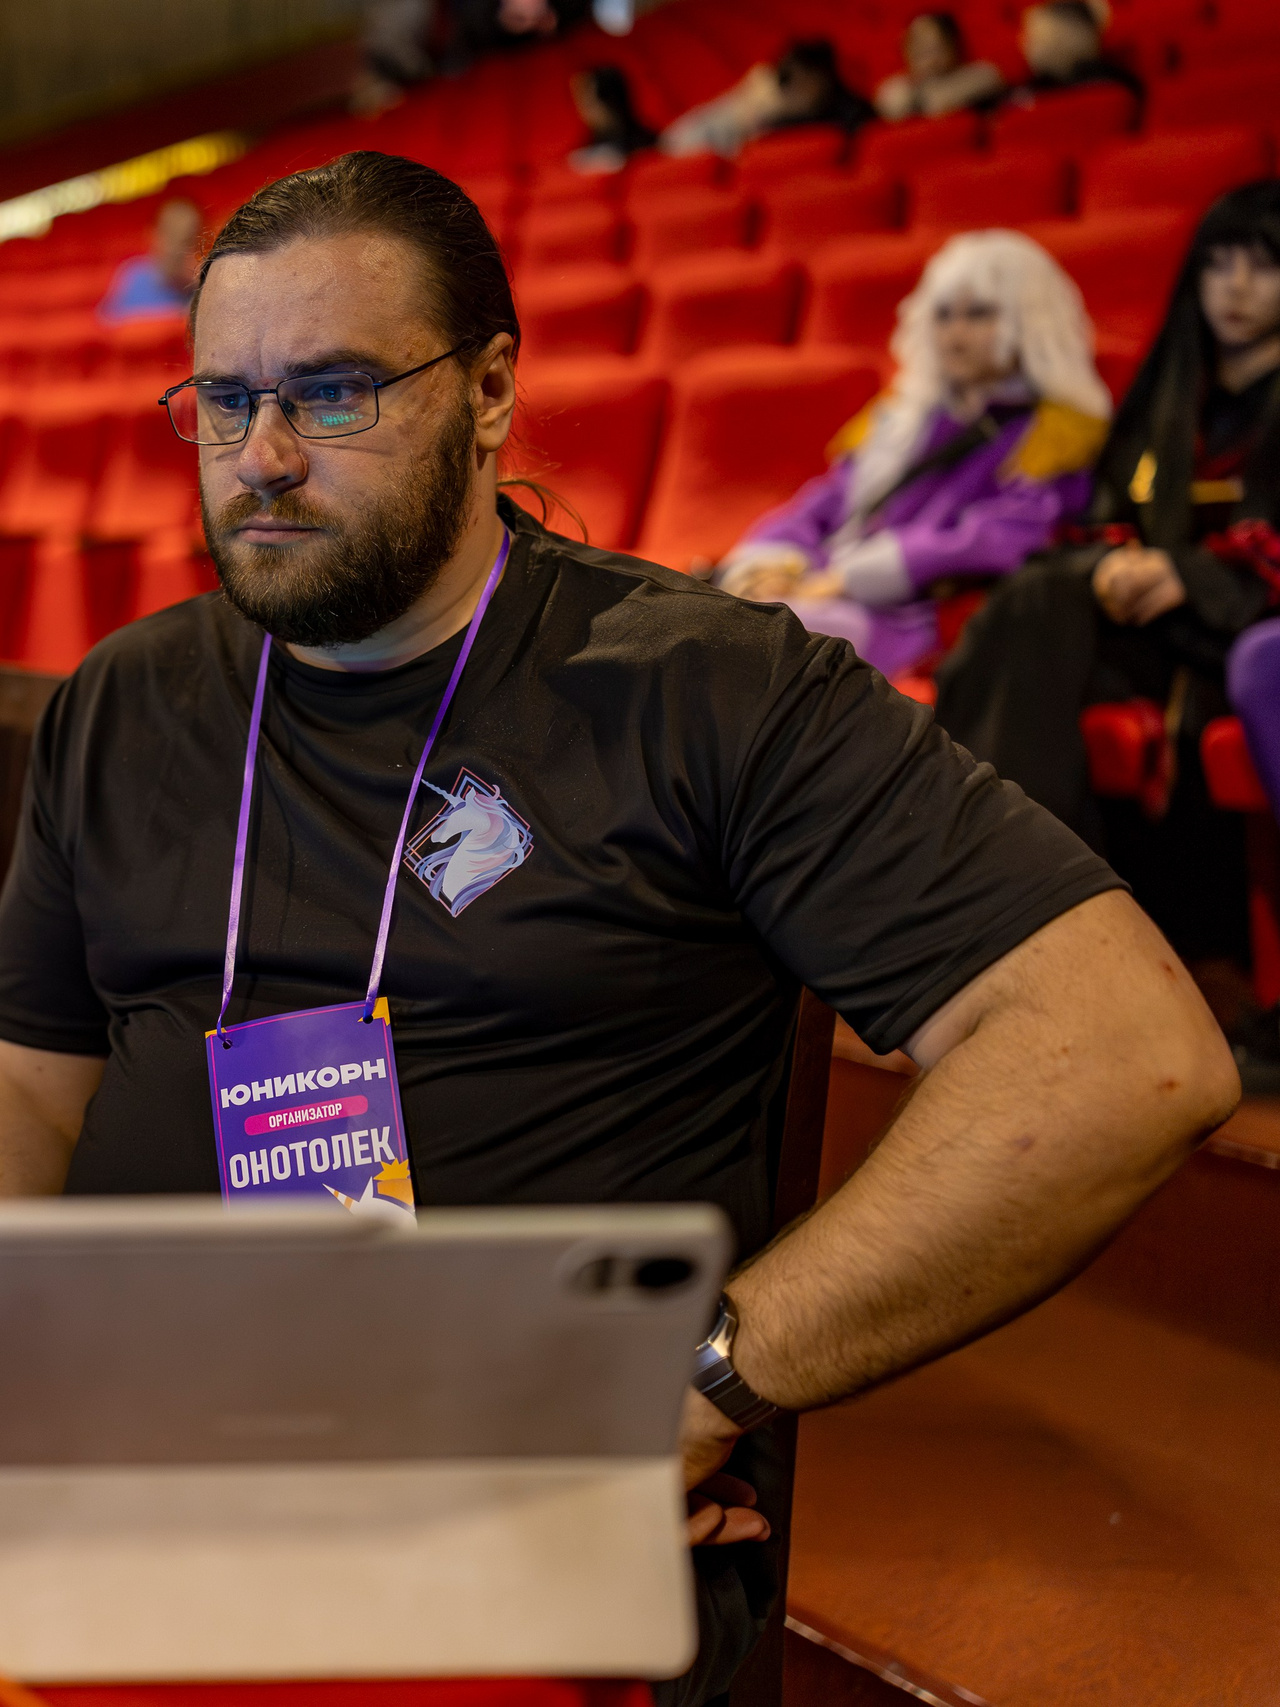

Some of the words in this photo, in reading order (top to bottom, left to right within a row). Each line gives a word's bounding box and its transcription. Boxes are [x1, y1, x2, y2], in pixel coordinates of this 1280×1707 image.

[220, 1058, 387, 1109] ЮНИКОРН
[268, 1103, 343, 1128] ОРГАНИЗАТОР
[229, 1126, 396, 1189] ОНОТОЛЕК
